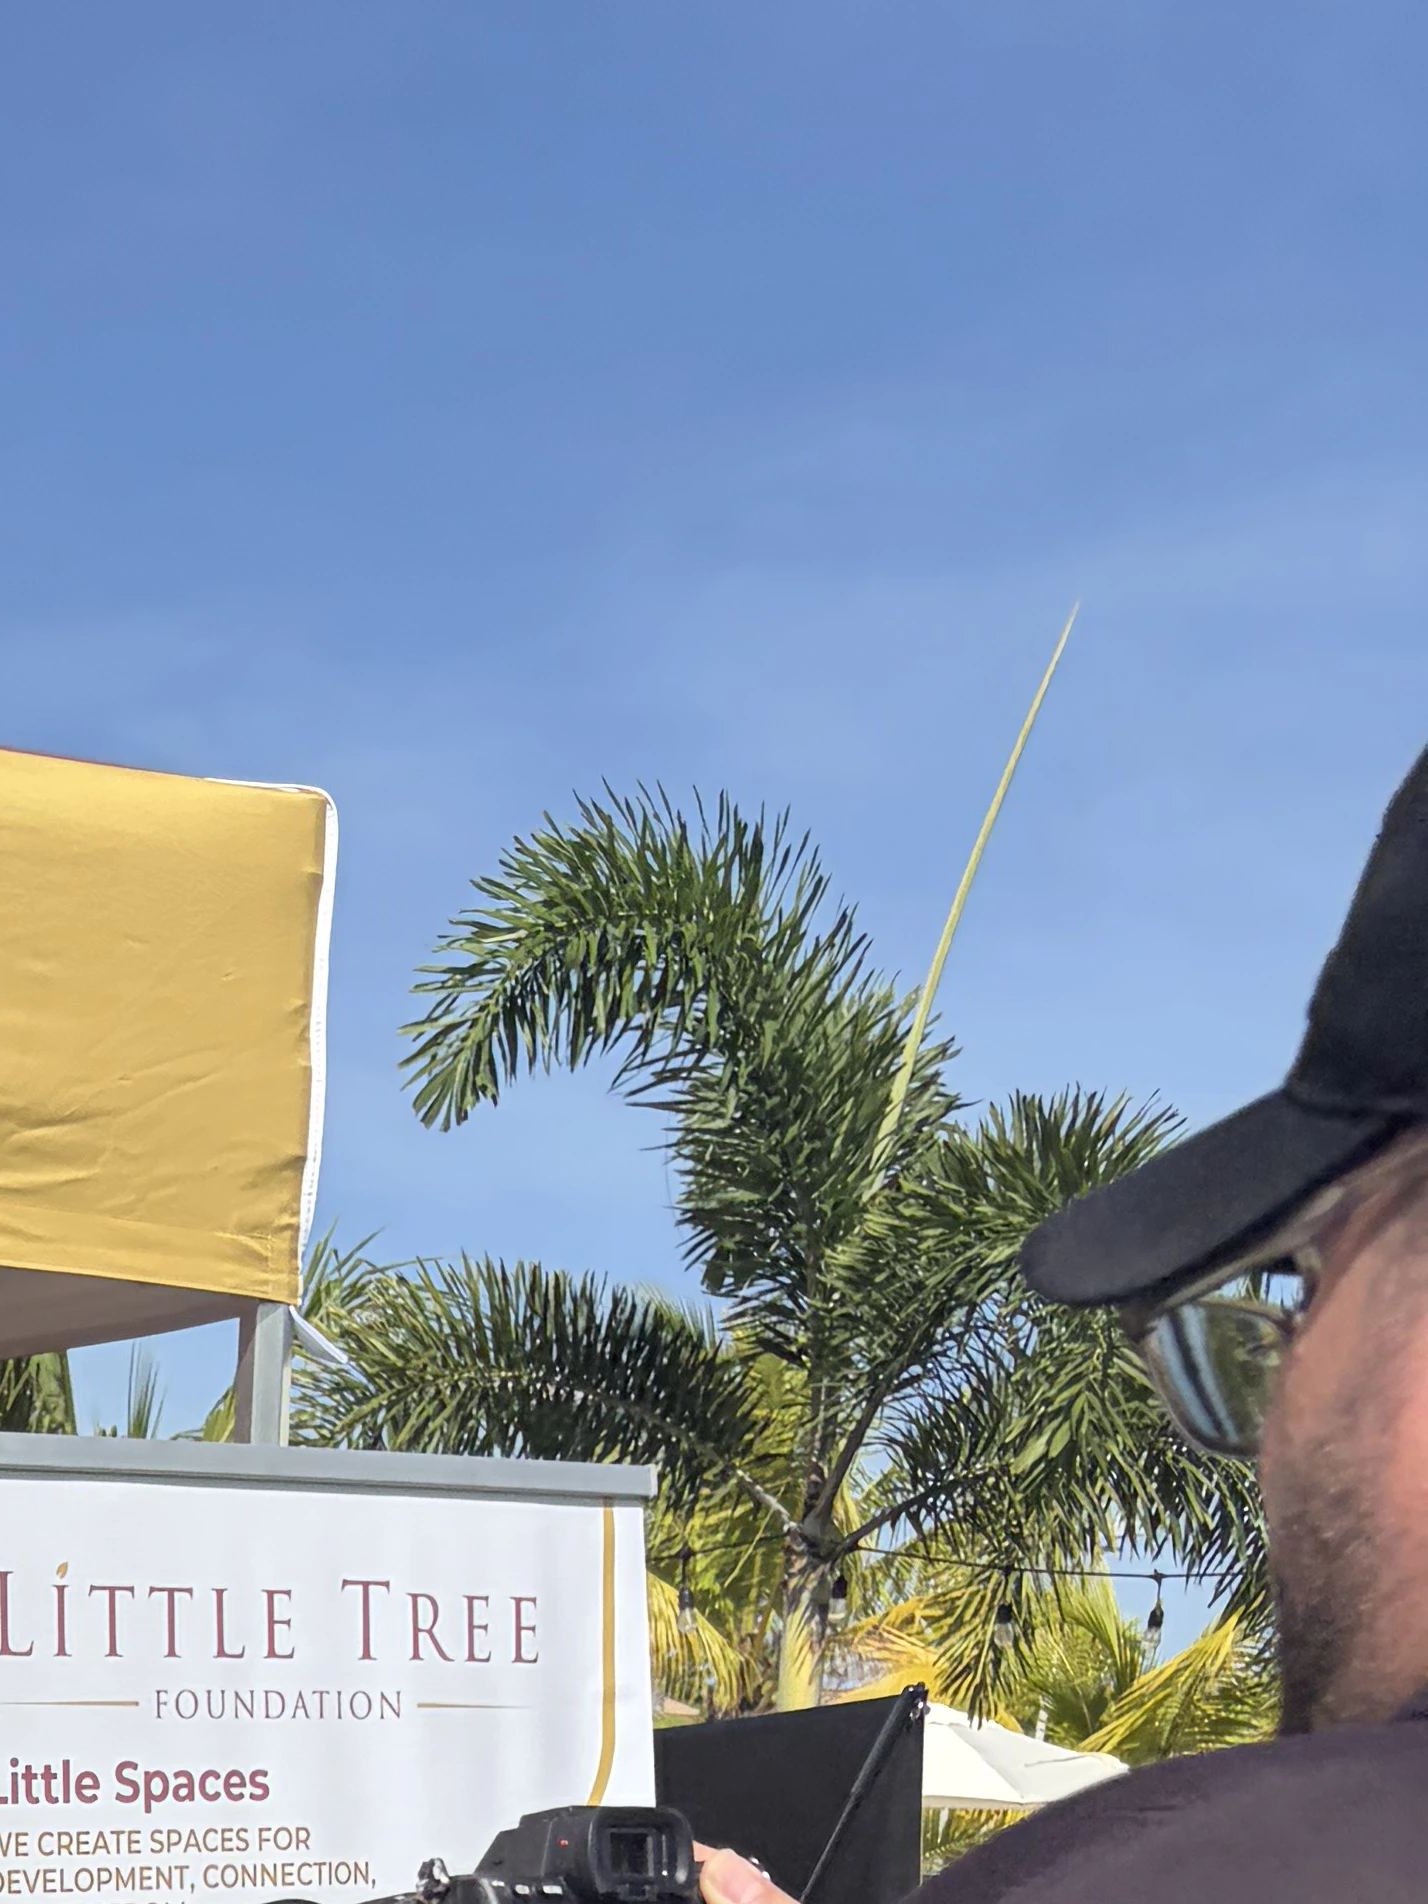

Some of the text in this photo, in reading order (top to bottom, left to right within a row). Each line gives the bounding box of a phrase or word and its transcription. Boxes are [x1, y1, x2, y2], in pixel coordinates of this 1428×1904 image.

[341, 1579, 540, 1666] TREE
[154, 1690, 403, 1721] FOUNDATION
[115, 1761, 270, 1814] Spaces
[38, 1830, 142, 1856] CREATE
[150, 1827, 249, 1854] SPACES
[258, 1827, 310, 1852] FOR
[203, 1861, 375, 1888] CONNECTION,
